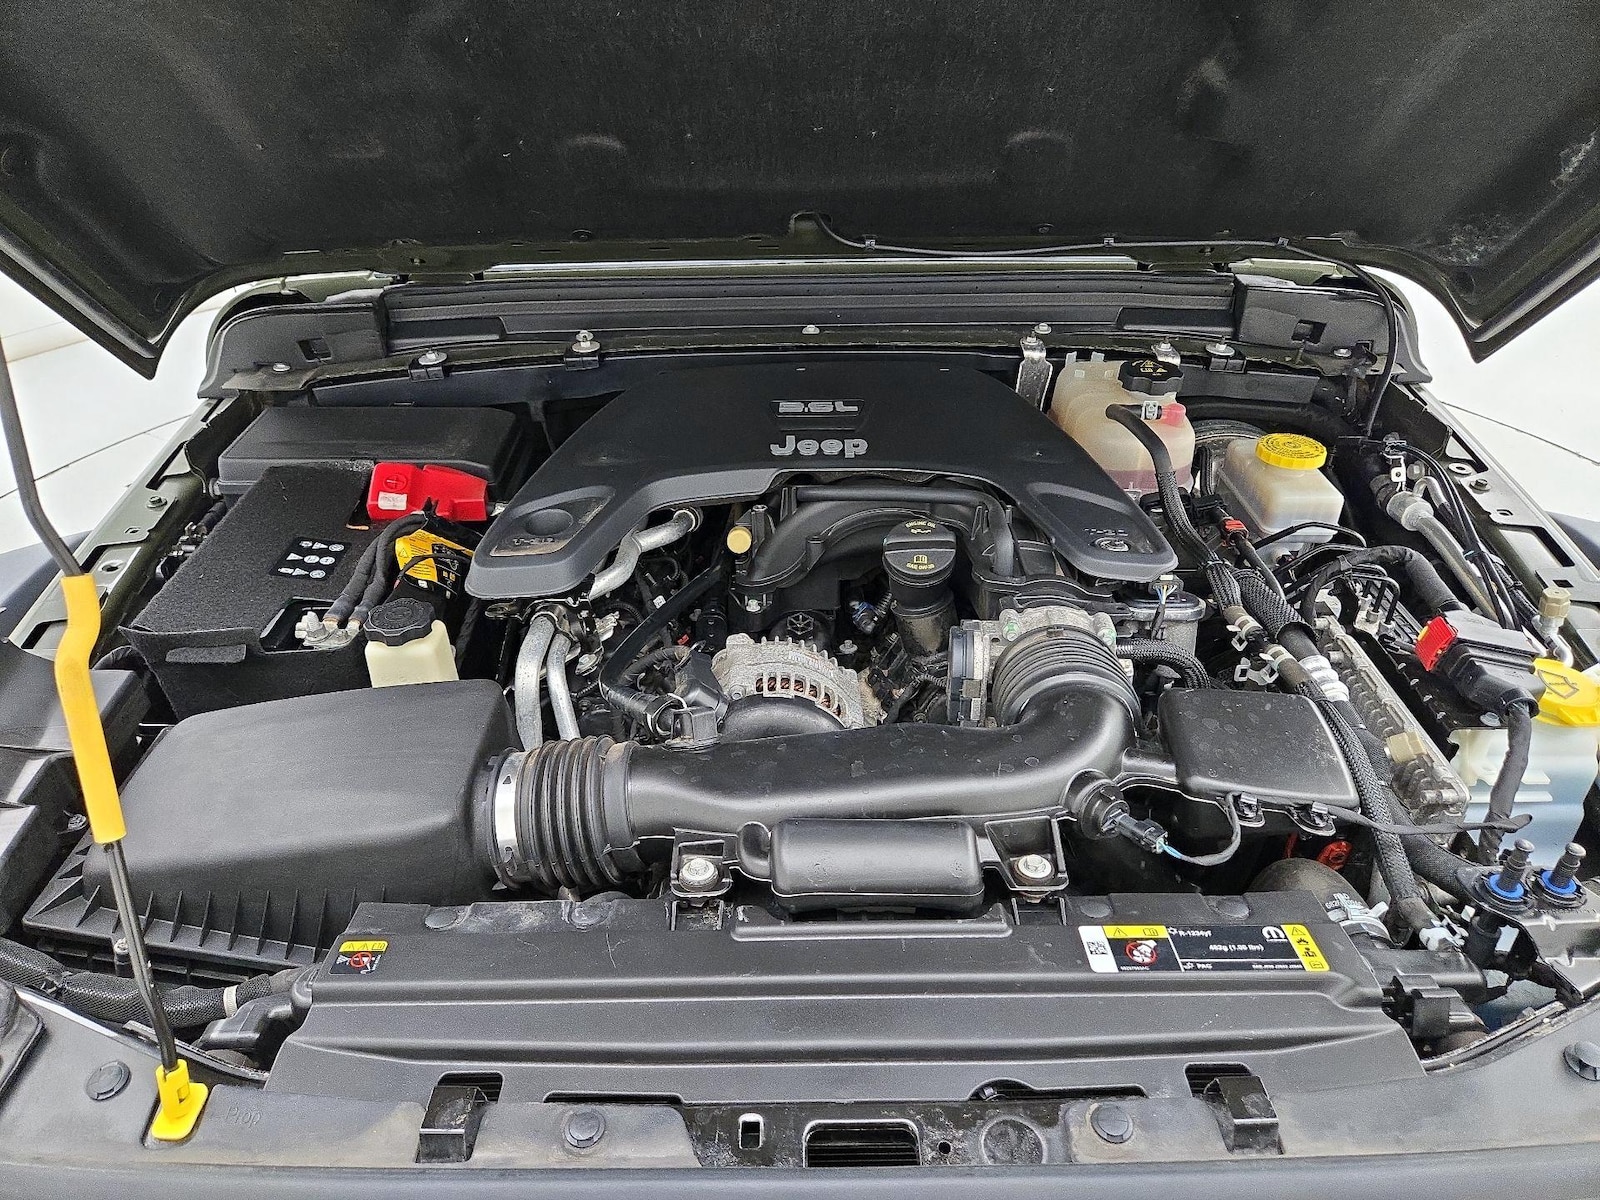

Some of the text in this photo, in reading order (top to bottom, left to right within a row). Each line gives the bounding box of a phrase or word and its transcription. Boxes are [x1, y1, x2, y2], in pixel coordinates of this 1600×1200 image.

[769, 435, 869, 459] Jeep
[905, 520, 936, 529] ENGINE OIL
